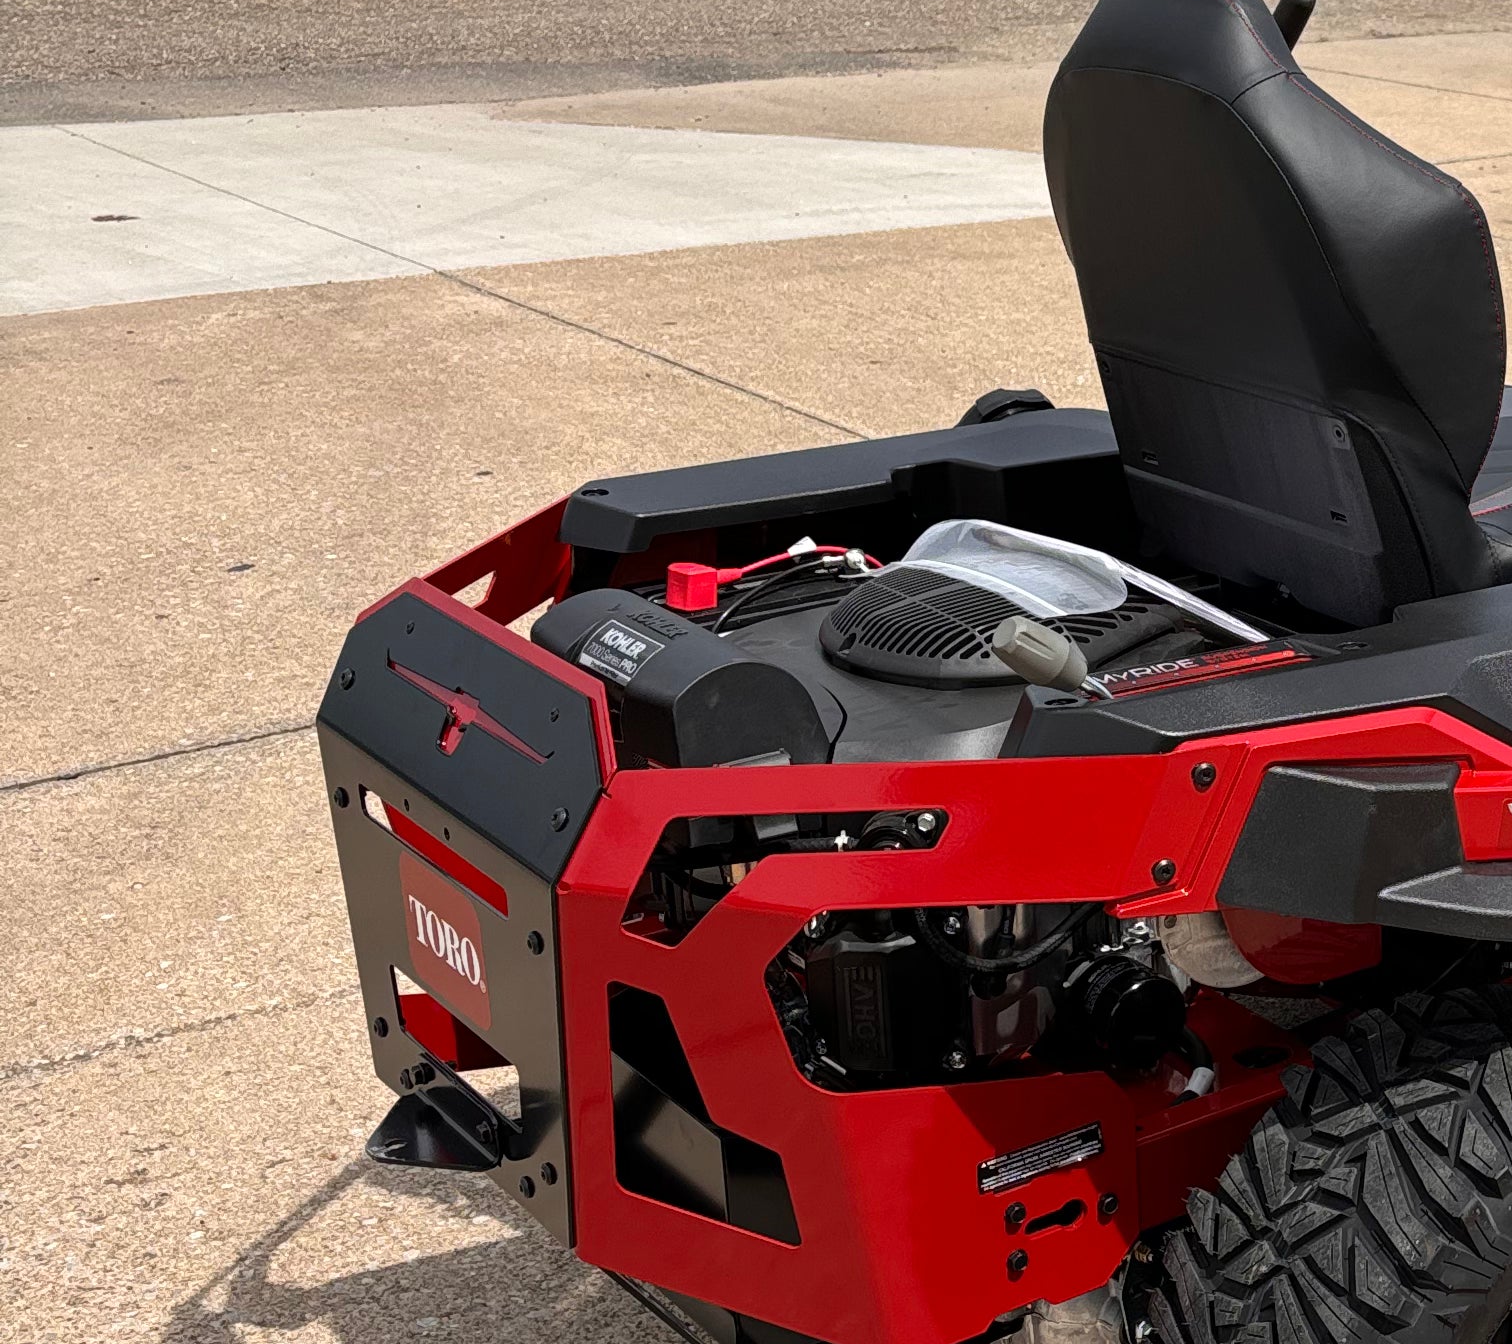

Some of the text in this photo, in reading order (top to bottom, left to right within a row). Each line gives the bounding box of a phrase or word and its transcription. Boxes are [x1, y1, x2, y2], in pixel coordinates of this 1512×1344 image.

[586, 641, 606, 659] 7000
[601, 649, 622, 667] Series
[619, 658, 638, 674] PRO
[599, 627, 647, 660] KOHLER
[408, 894, 481, 986] TORO
